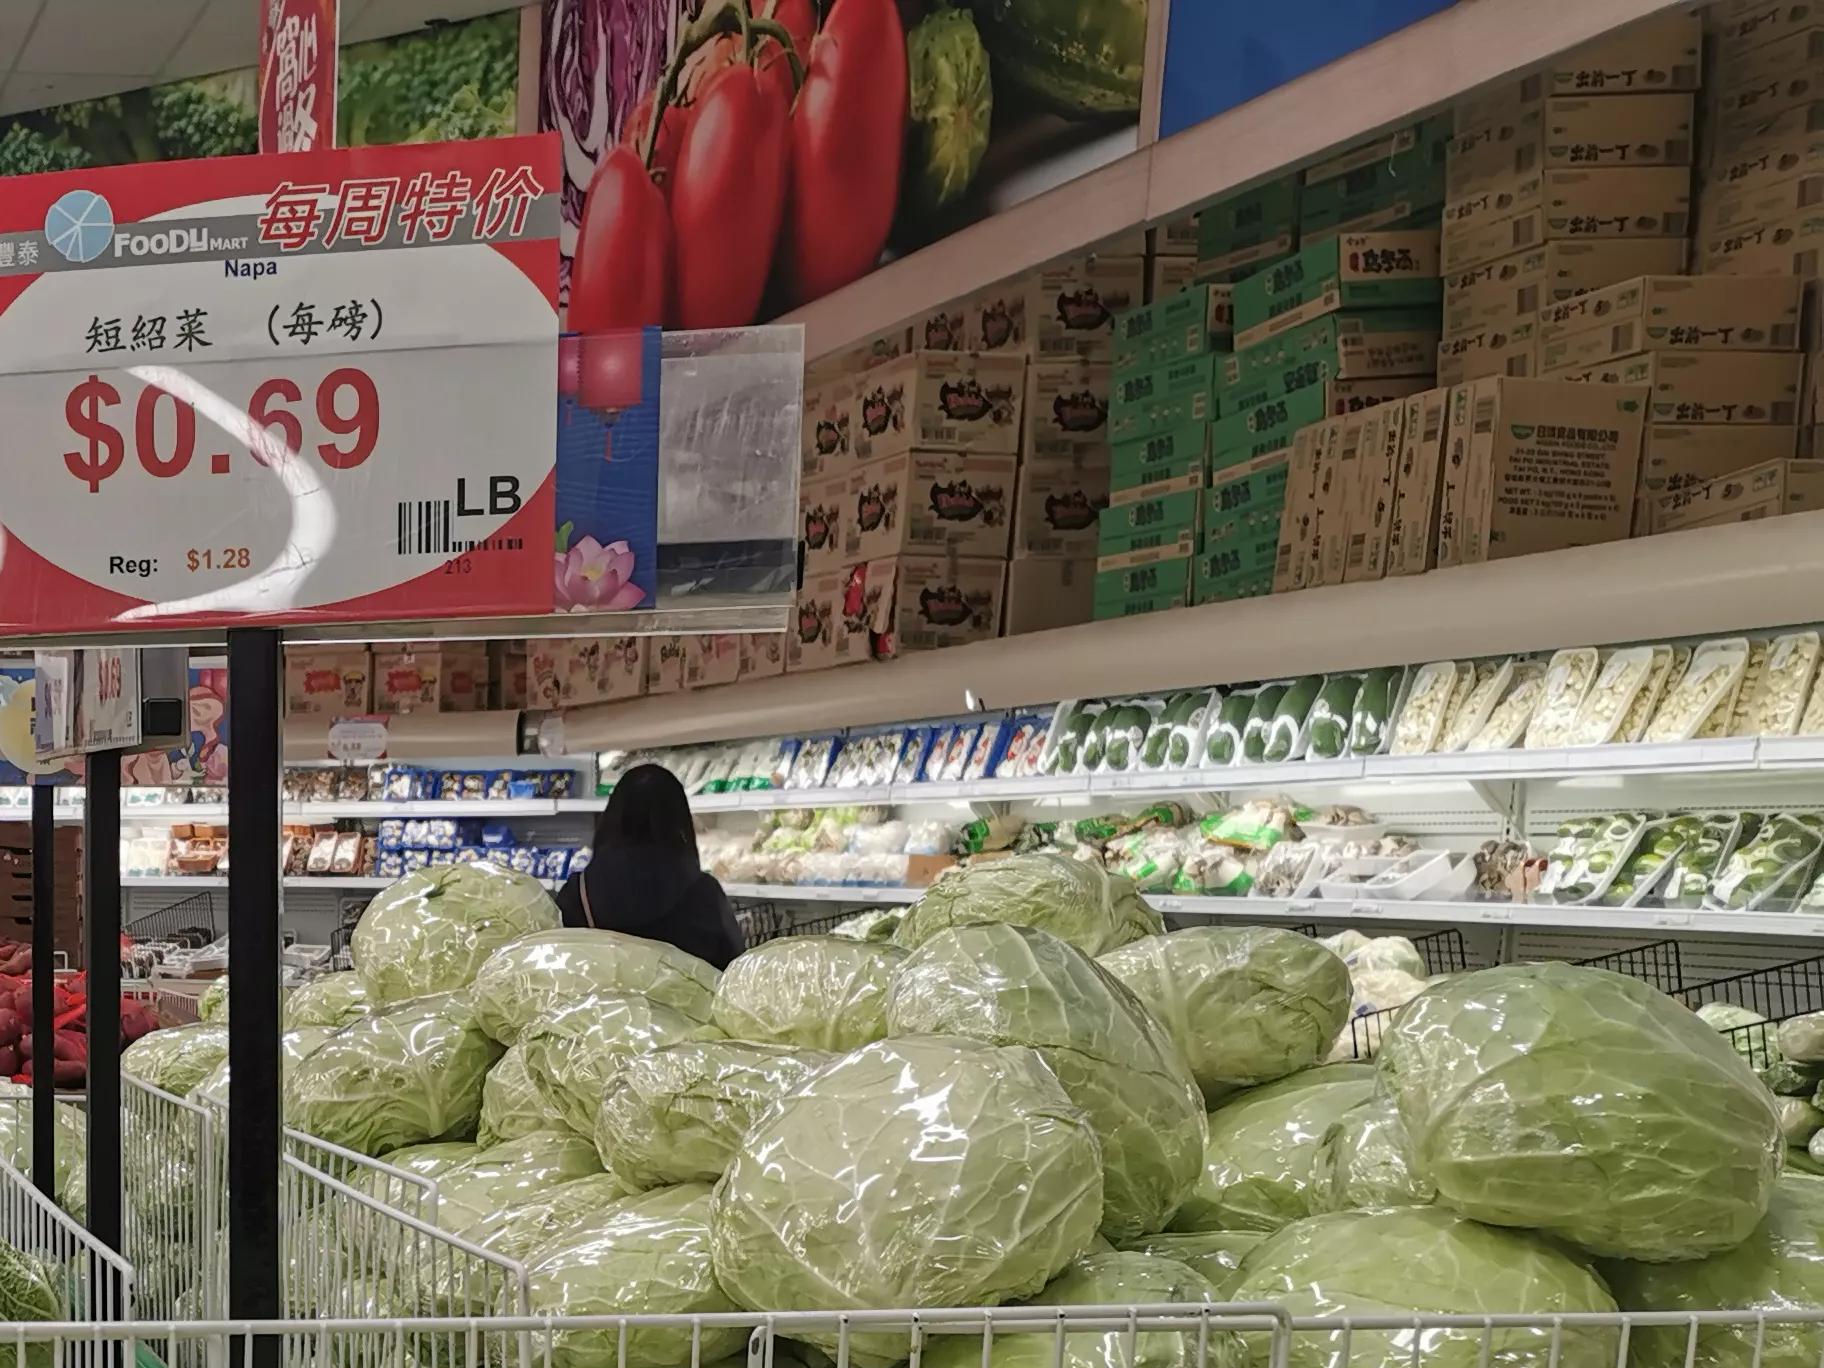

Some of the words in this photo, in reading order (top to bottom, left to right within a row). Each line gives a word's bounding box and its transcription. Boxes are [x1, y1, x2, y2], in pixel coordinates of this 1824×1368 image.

[258, 165, 545, 252] 每周特价
[209, 236, 248, 251] MART
[225, 259, 277, 280] Napa
[85, 308, 214, 353] 短紹菜
[64, 367, 380, 494] $0.69
[457, 476, 522, 516] LB
[109, 555, 159, 578] Reg:
[186, 547, 251, 572] $1.28
